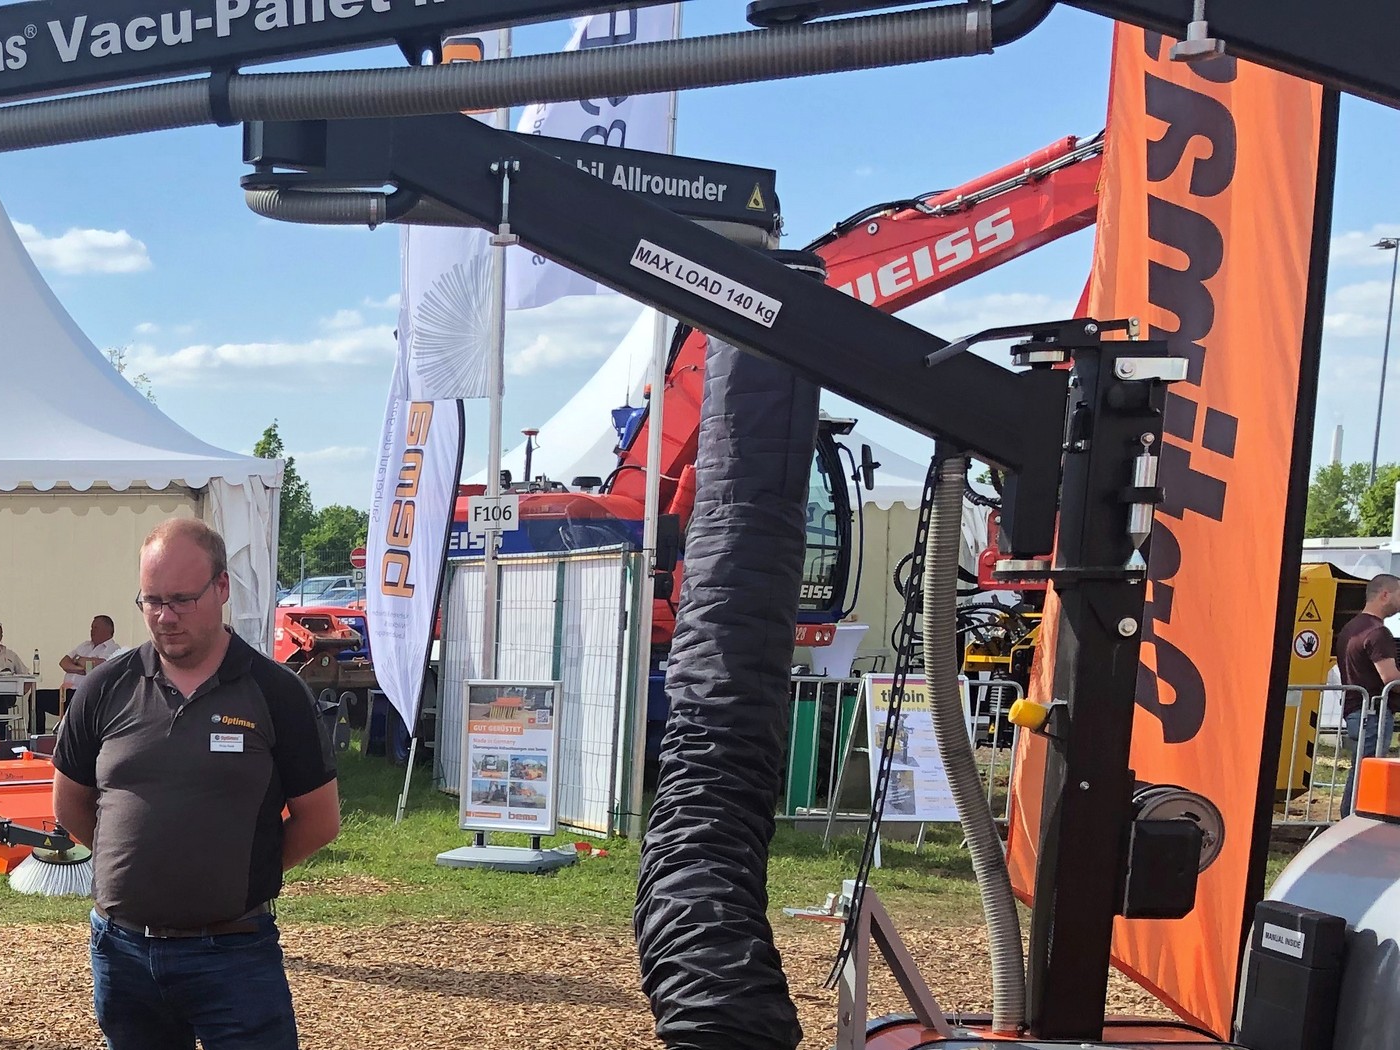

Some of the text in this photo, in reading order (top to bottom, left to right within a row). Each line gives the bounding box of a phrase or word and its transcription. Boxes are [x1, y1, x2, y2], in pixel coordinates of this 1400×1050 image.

[611, 164, 727, 201] Allrounder
[635, 246, 775, 324] MAX LOAD 140 kg
[474, 504, 512, 521] F106
[881, 690, 924, 702] tibin
[221, 715, 256, 729] Optimas
[473, 724, 487, 732] GUT
[508, 811, 537, 821] bema
